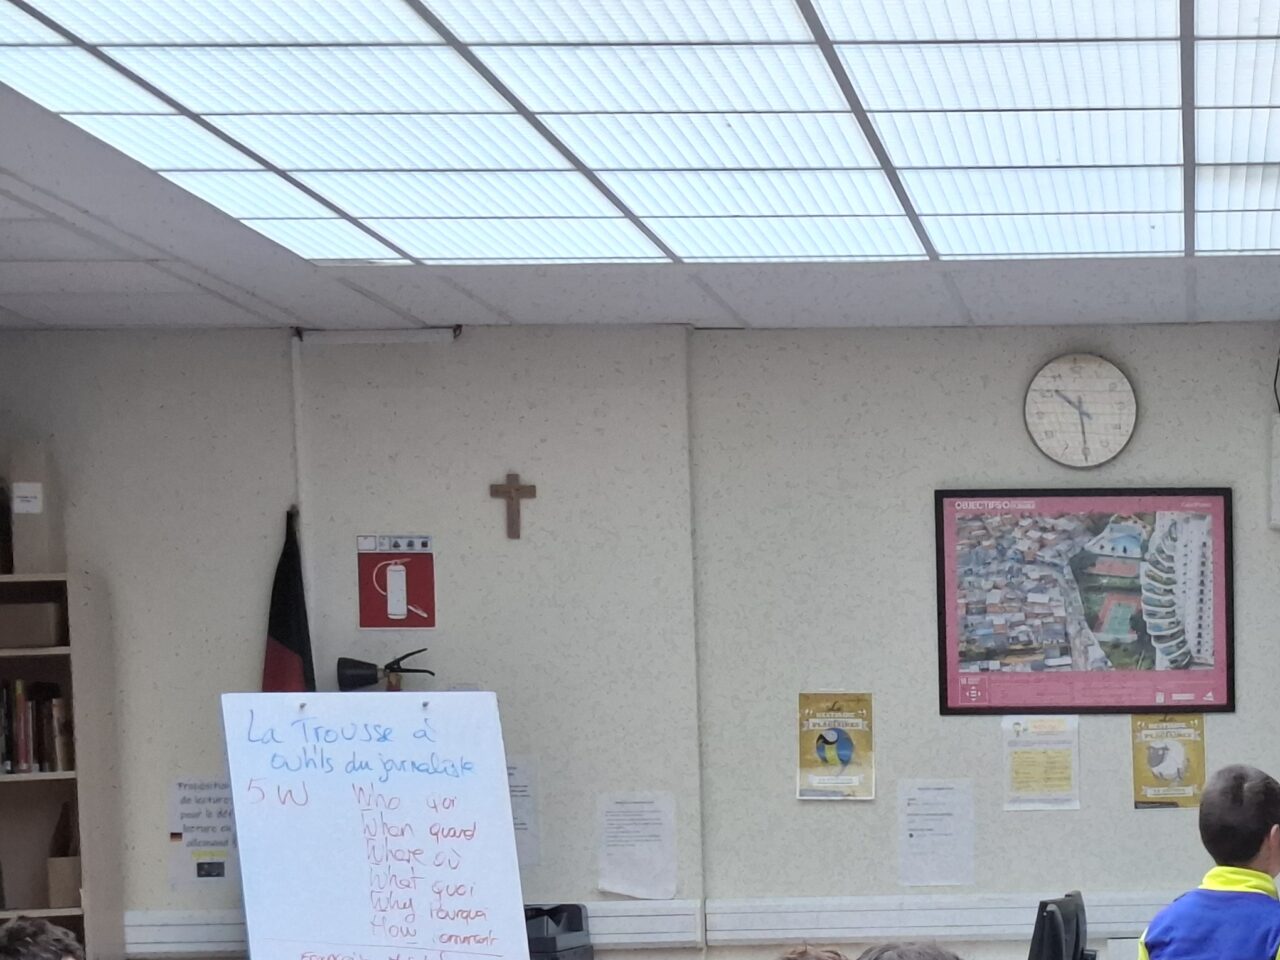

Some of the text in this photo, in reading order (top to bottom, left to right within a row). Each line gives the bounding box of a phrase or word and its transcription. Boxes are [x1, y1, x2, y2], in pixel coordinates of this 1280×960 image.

[248, 709, 283, 744] La
[291, 716, 395, 743] Trousse
[345, 751, 373, 774] du
[247, 777, 266, 805] 5
[352, 782, 401, 811] Who
[362, 812, 415, 839] When
[367, 838, 426, 865] Where
[369, 864, 424, 890] What
[370, 891, 416, 923] Why
[370, 915, 417, 939] How
